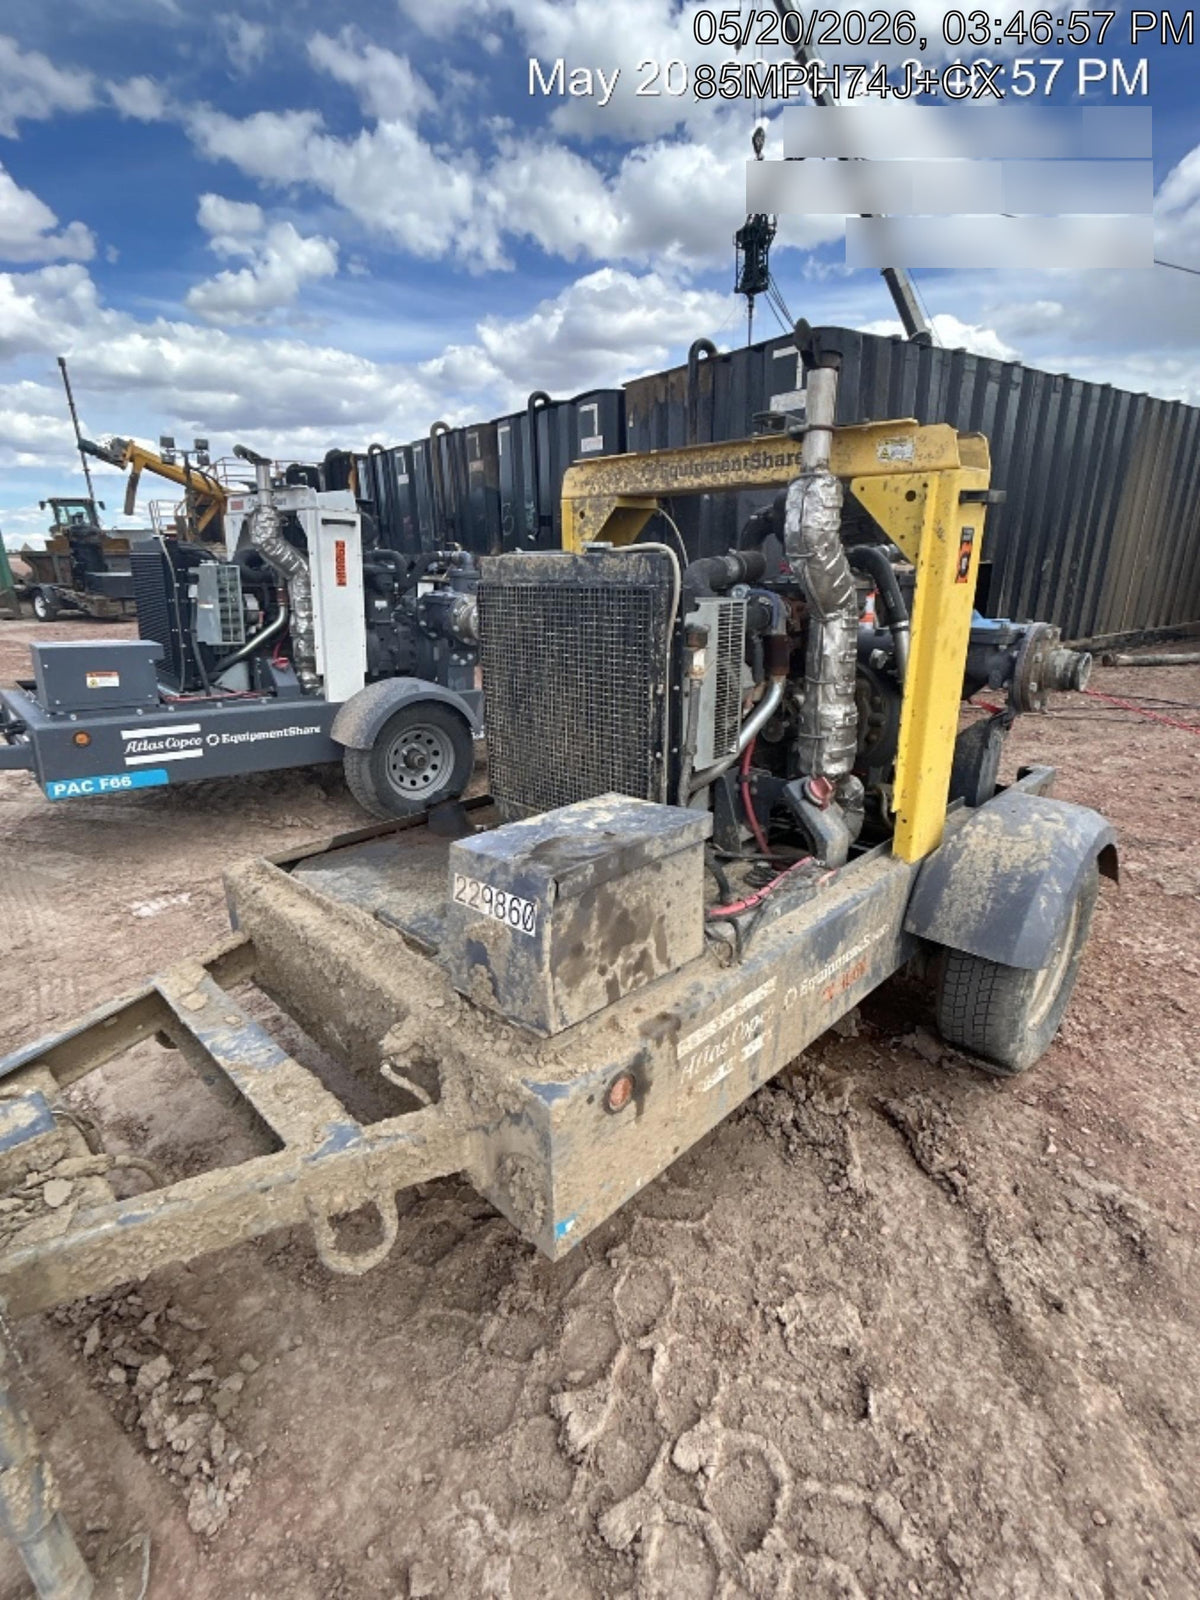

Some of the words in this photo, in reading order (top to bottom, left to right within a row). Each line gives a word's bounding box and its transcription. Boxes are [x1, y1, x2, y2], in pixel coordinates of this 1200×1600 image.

[125, 737, 165, 754] Atlas
[165, 735, 203, 750] Copco
[221, 725, 321, 745] EquipmentShare
[53, 780, 95, 797] PAC
[99, 776, 132, 791] F66
[454, 875, 535, 932] 229860
